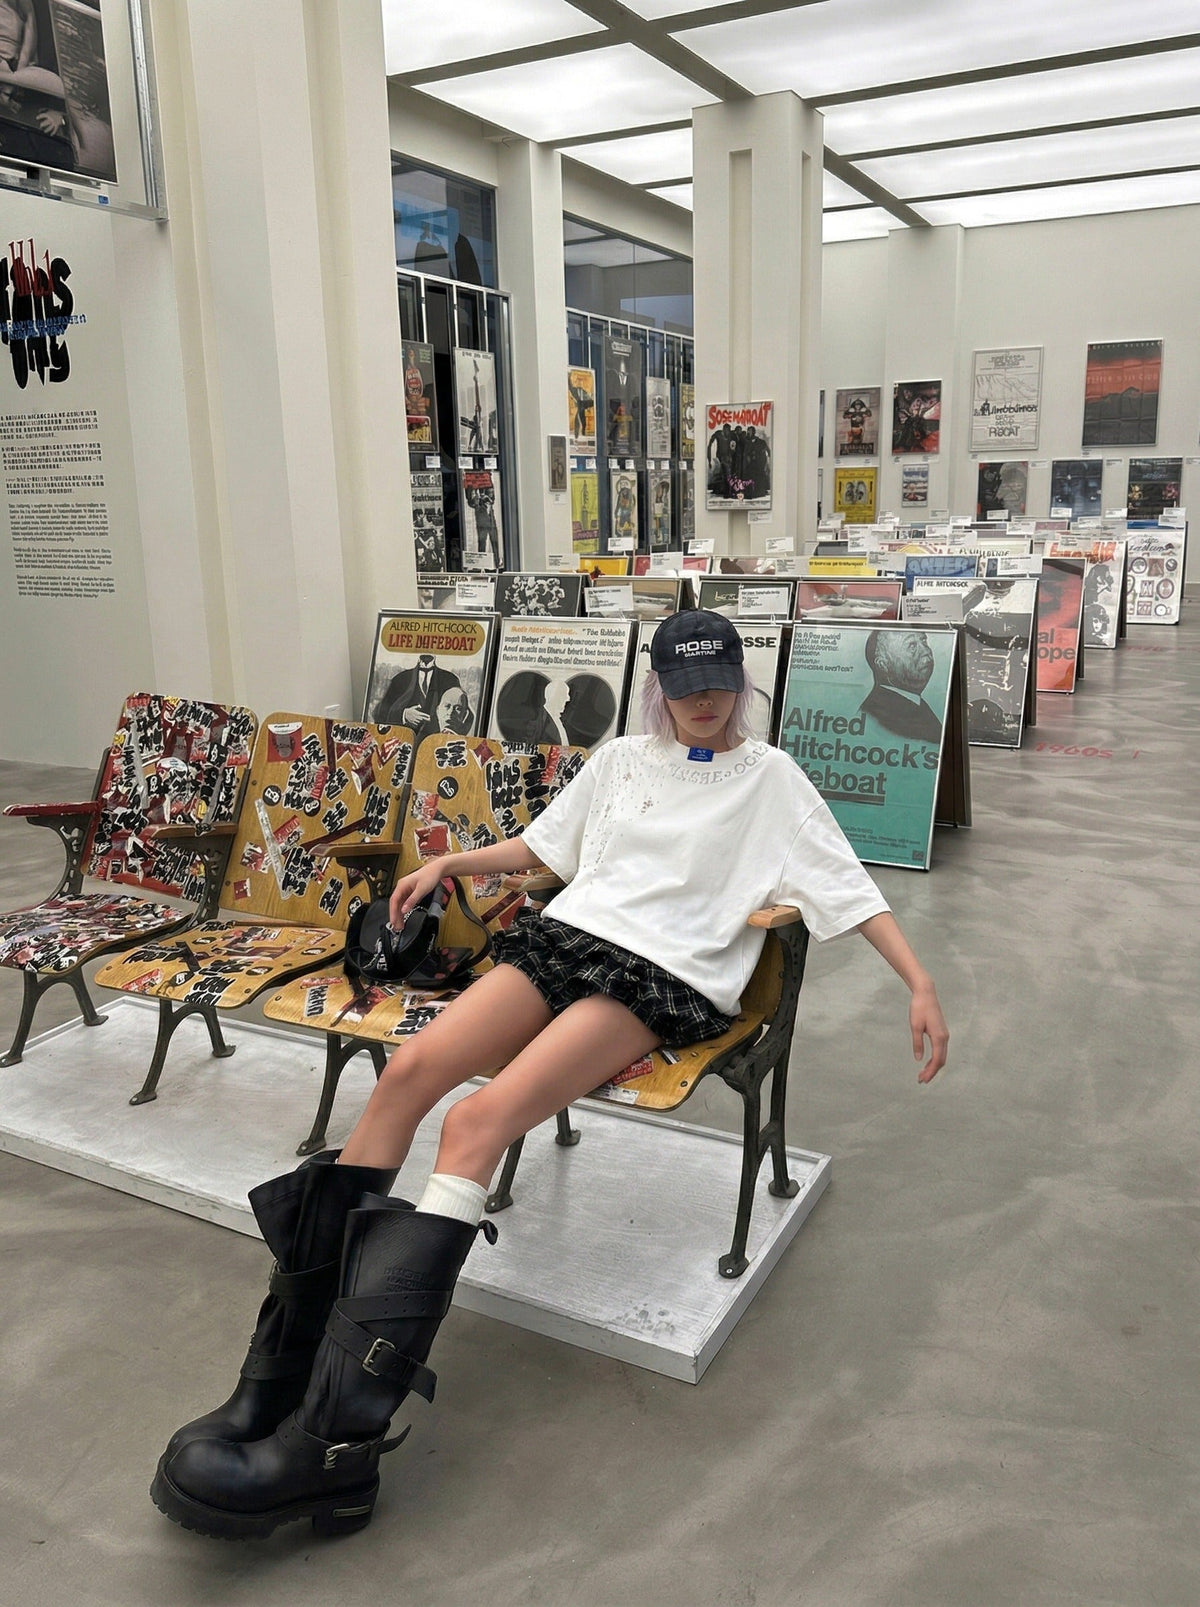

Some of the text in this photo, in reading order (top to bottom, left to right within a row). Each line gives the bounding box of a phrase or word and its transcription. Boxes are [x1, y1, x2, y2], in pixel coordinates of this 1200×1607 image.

[389, 621, 477, 634] ALFRED HITCHCOCK
[388, 633, 413, 648] LIFE
[675, 640, 724, 655] ROSE
[741, 636, 777, 648] SSE
[1038, 646, 1076, 663] ope
[784, 706, 867, 736] Alfred
[780, 733, 939, 770] Hitchcock's
